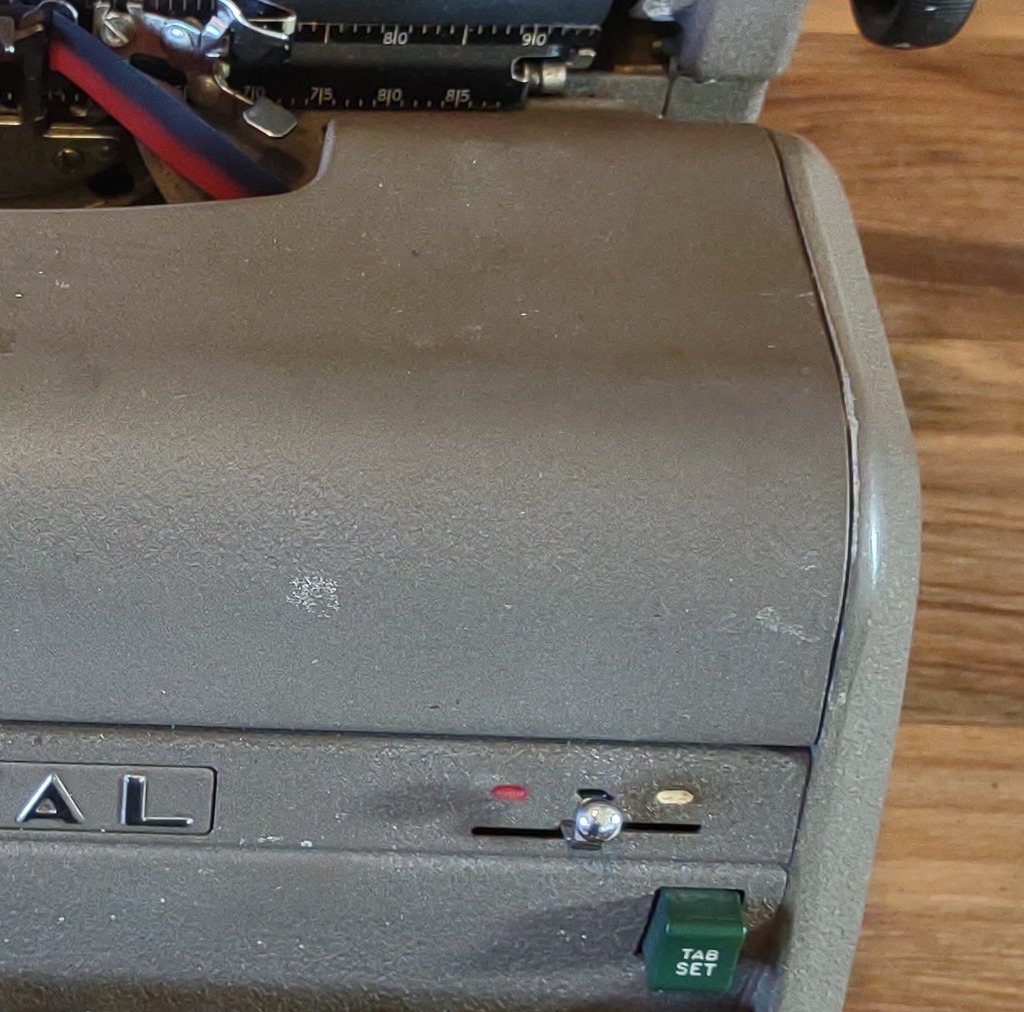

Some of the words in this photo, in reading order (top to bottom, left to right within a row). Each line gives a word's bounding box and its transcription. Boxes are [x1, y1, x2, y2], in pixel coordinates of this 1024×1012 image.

[382, 29, 408, 46] 80
[521, 32, 547, 47] 90
[310, 88, 333, 103] 75
[377, 89, 403, 104] 80
[445, 90, 471, 105] 85
[681, 948, 719, 962] TAB
[675, 961, 718, 977] SET
